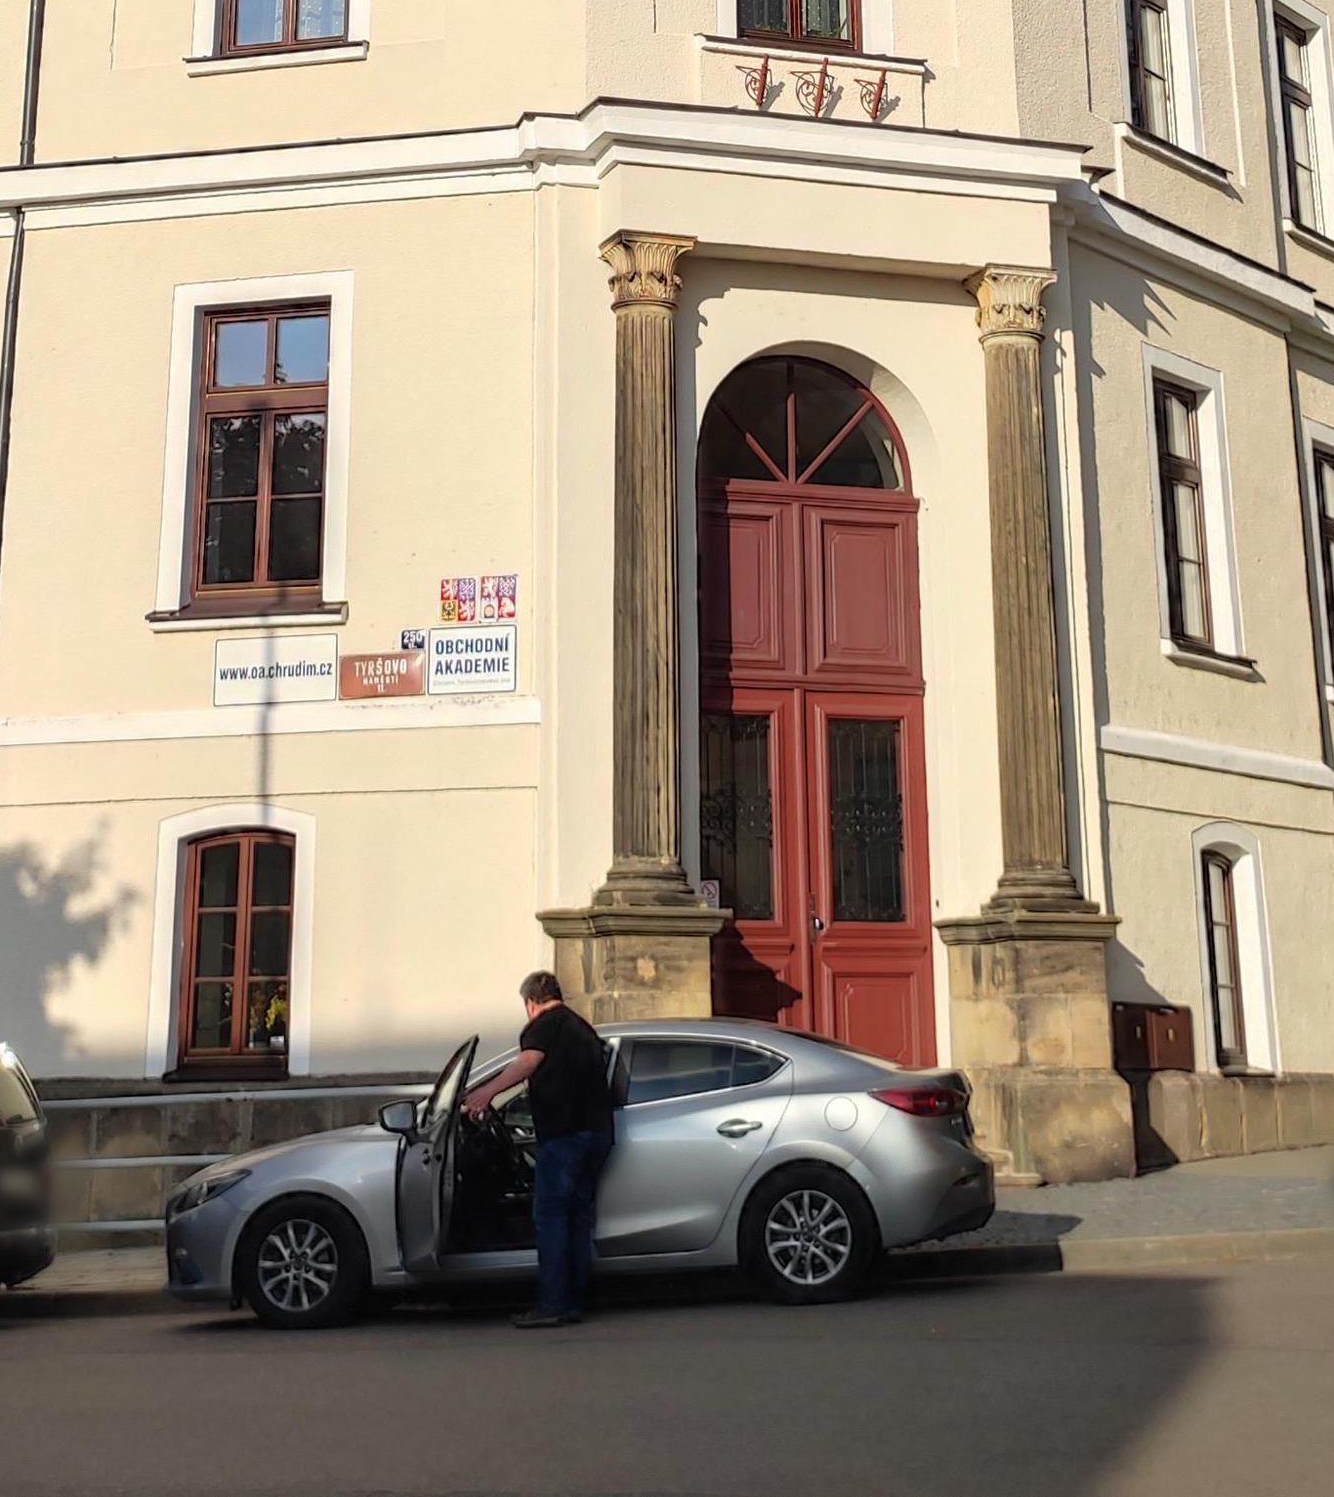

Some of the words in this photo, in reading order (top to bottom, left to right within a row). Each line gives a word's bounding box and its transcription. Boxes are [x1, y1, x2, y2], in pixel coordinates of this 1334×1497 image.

[403, 631, 423, 643] 250
[435, 633, 511, 655] OBCHODNÍ
[354, 657, 407, 678] TYRŠOVO
[435, 657, 510, 675] AKADEMIE
